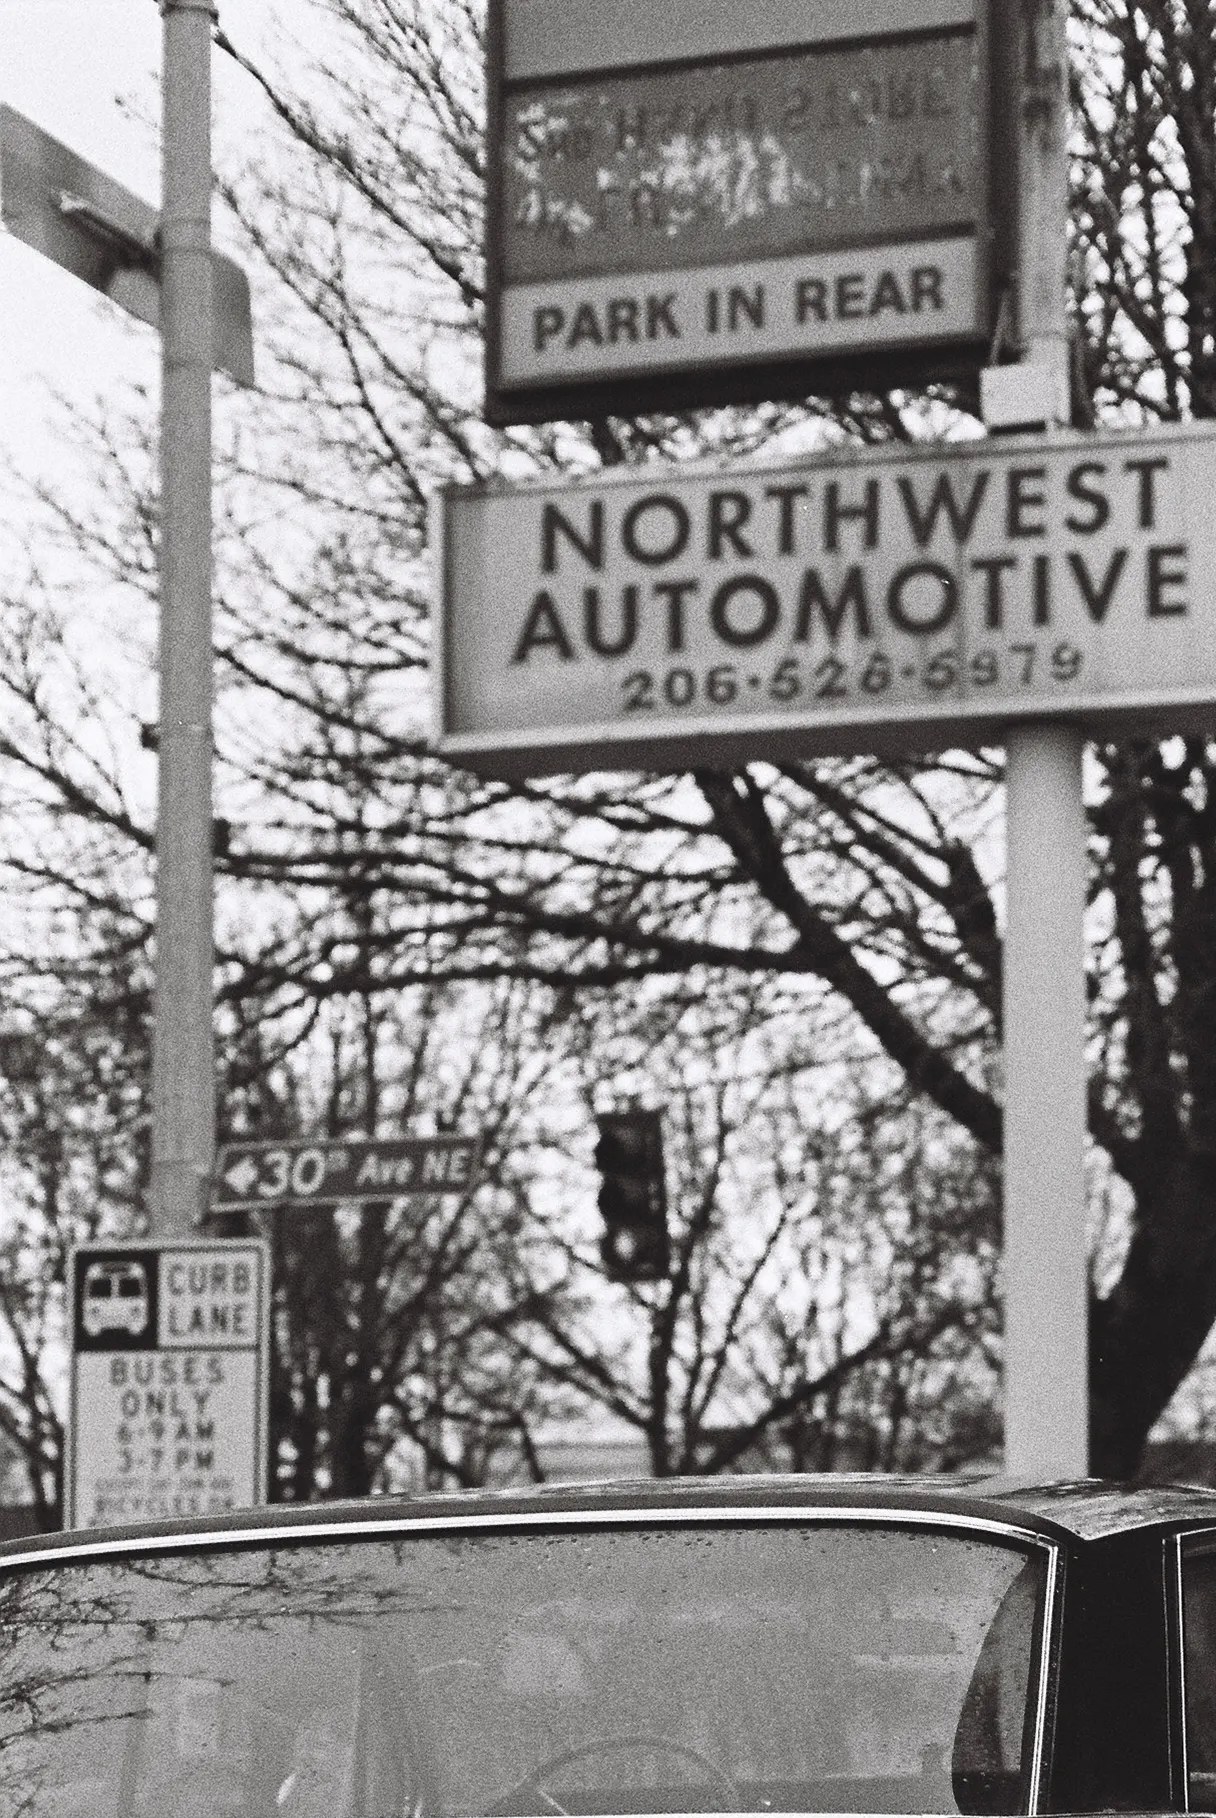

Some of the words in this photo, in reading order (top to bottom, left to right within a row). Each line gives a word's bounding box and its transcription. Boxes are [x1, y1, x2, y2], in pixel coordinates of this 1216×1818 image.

[532, 293, 682, 352] PARK
[706, 283, 767, 334] IN
[795, 264, 944, 324] REAR
[540, 456, 1170, 576] NORTHWEST
[509, 543, 1189, 666] AUTOMOTIVE
[355, 1152, 414, 1187] Ave
[421, 1147, 470, 1185] NE
[167, 1262, 251, 1297] CURB
[167, 1303, 249, 1337] LANE
[109, 1355, 226, 1388] BUSES
[121, 1387, 212, 1421] ONLY
[174, 1418, 215, 1442] AM
[174, 1448, 215, 1472] PM
